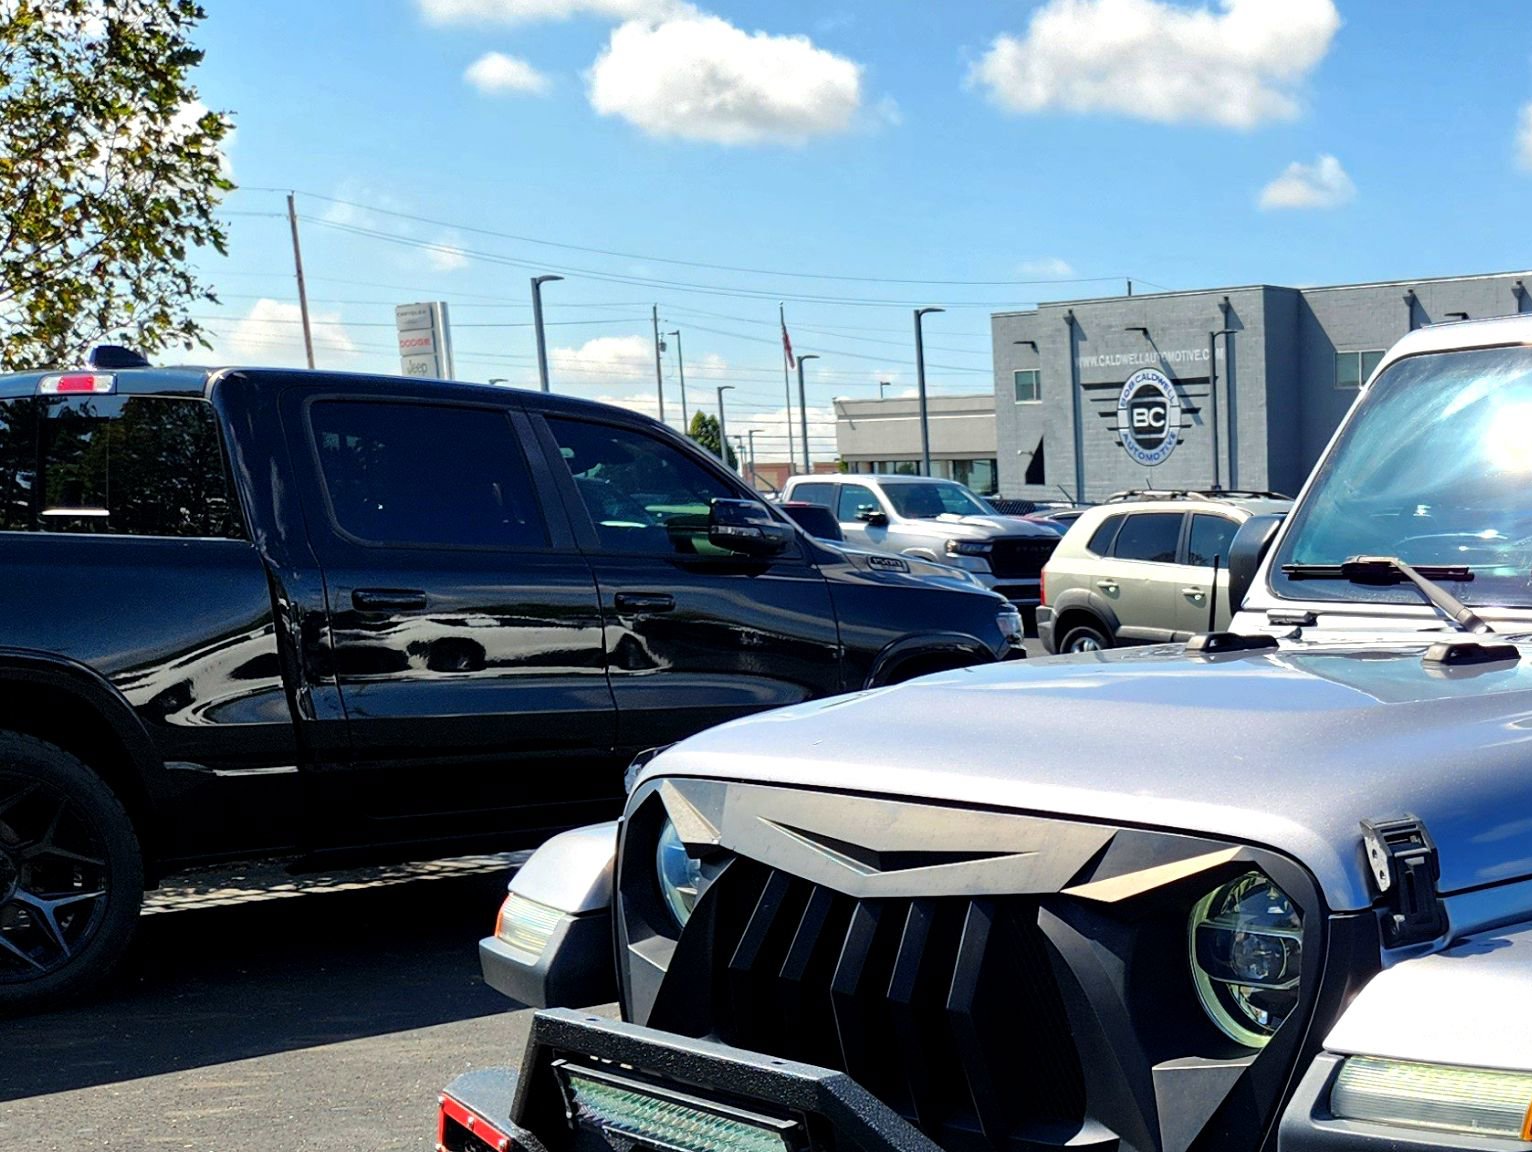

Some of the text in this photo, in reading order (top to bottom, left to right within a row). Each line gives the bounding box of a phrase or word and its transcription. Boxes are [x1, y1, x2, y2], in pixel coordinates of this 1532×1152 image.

[400, 337, 431, 347] DODGE
[1074, 347, 1224, 368] WWW.CALDWELLAUTOMOTIVE.CM
[406, 360, 428, 376] Jeep
[1120, 373, 1175, 407] BOB CALDWELL
[1132, 407, 1165, 427] BC
[1123, 432, 1177, 461] AUTOMOTIVE
